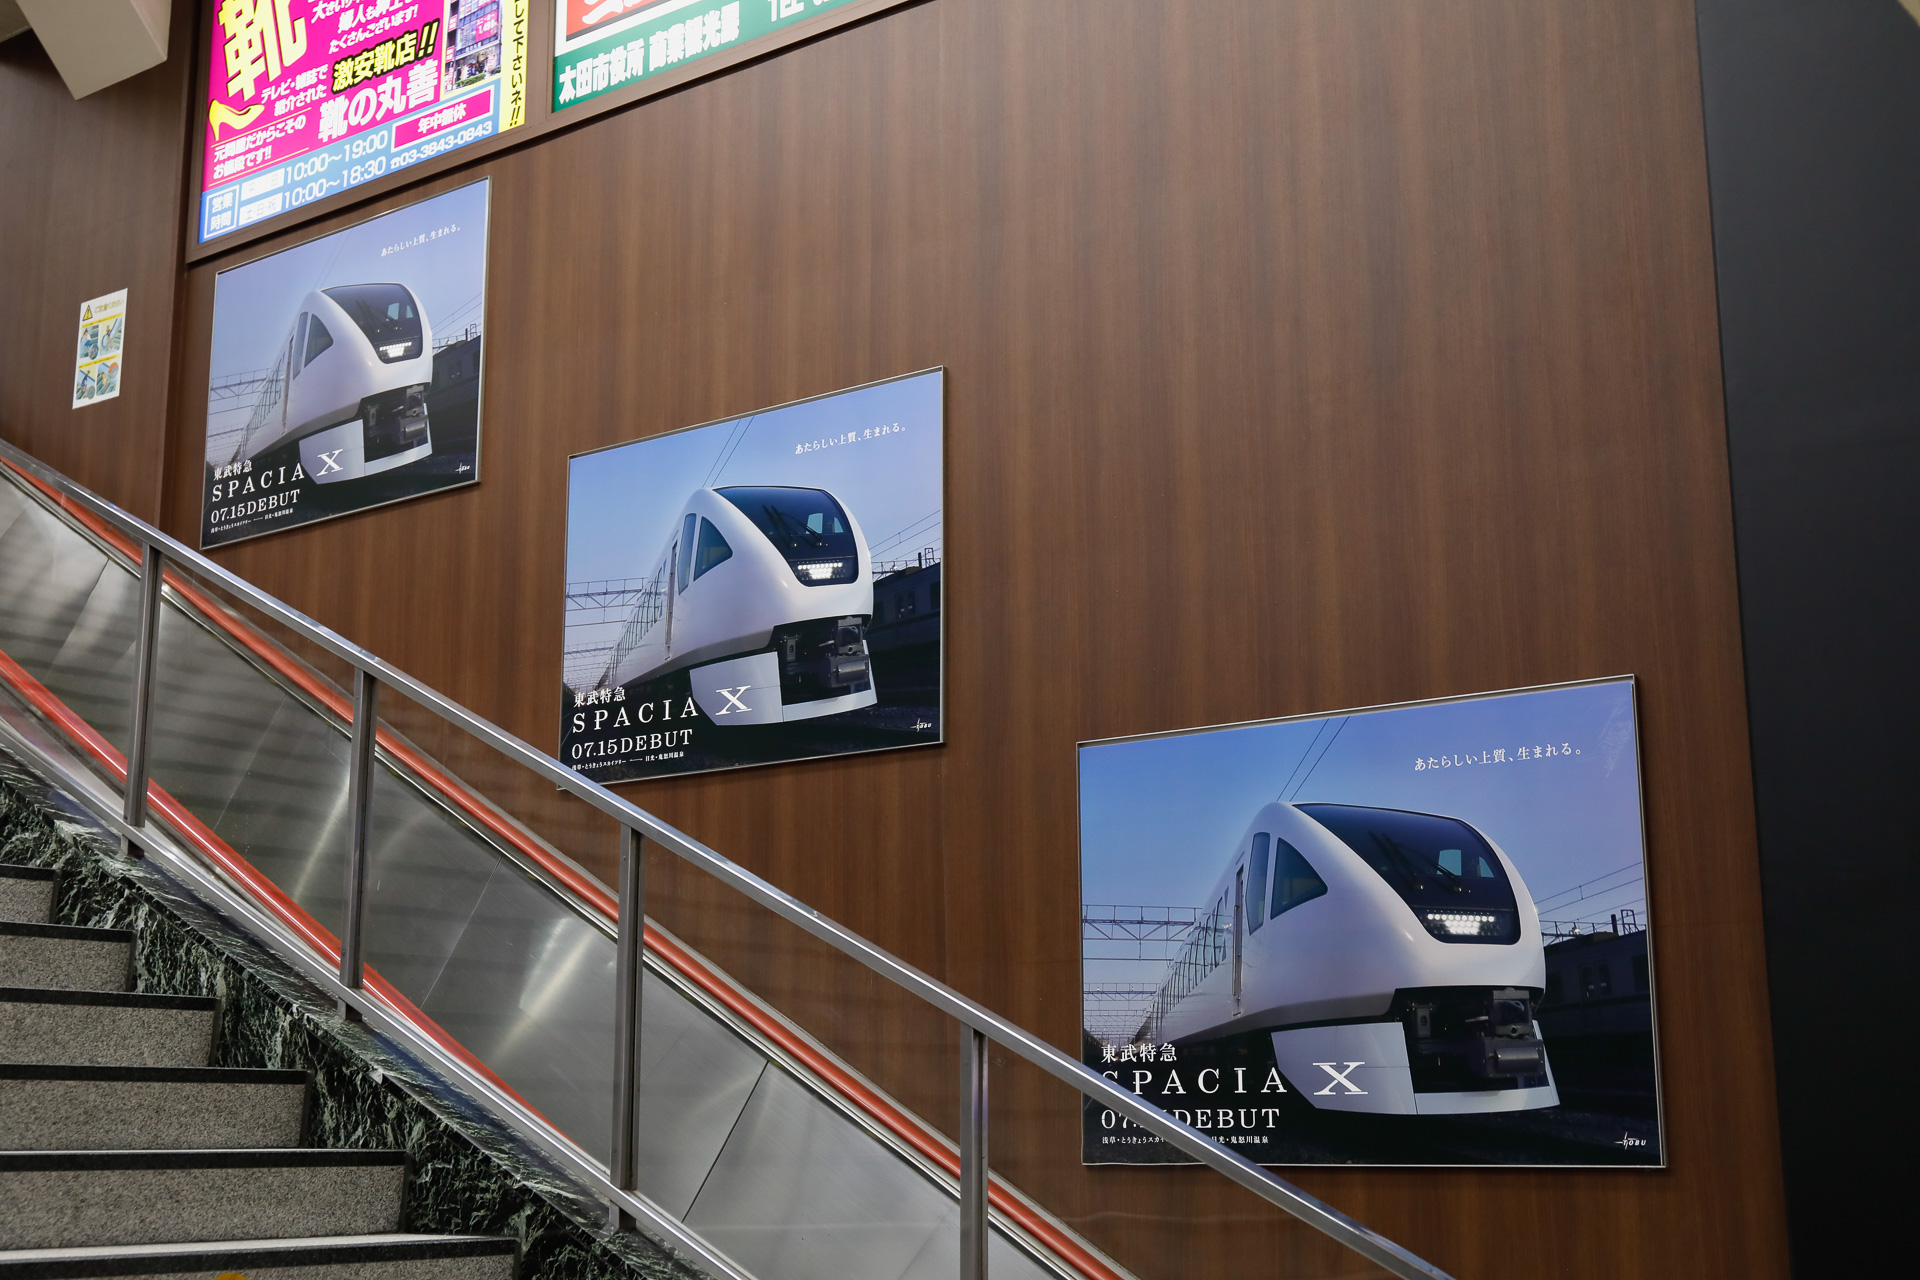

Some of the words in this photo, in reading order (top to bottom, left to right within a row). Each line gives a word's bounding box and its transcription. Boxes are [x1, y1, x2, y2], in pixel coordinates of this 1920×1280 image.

[559, 38, 645, 104] 太田市役所
[318, 58, 439, 143] 靴の丸善
[417, 103, 467, 134] 年中無休
[211, 191, 234, 214] 営業
[209, 210, 232, 232] 時間
[795, 422, 906, 455] あたらしい上質、生まれる。
[211, 462, 305, 502] SPACIA
[316, 448, 344, 477] X
[213, 459, 253, 481] 東武特急
[571, 697, 699, 734] SPACIA
[715, 685, 752, 716] X
[573, 686, 626, 708] 東武特急
[1414, 742, 1582, 771] あたらしい上質、生まれる。
[1101, 1042, 1177, 1064] 東武特急
[1312, 1061, 1369, 1095] X
